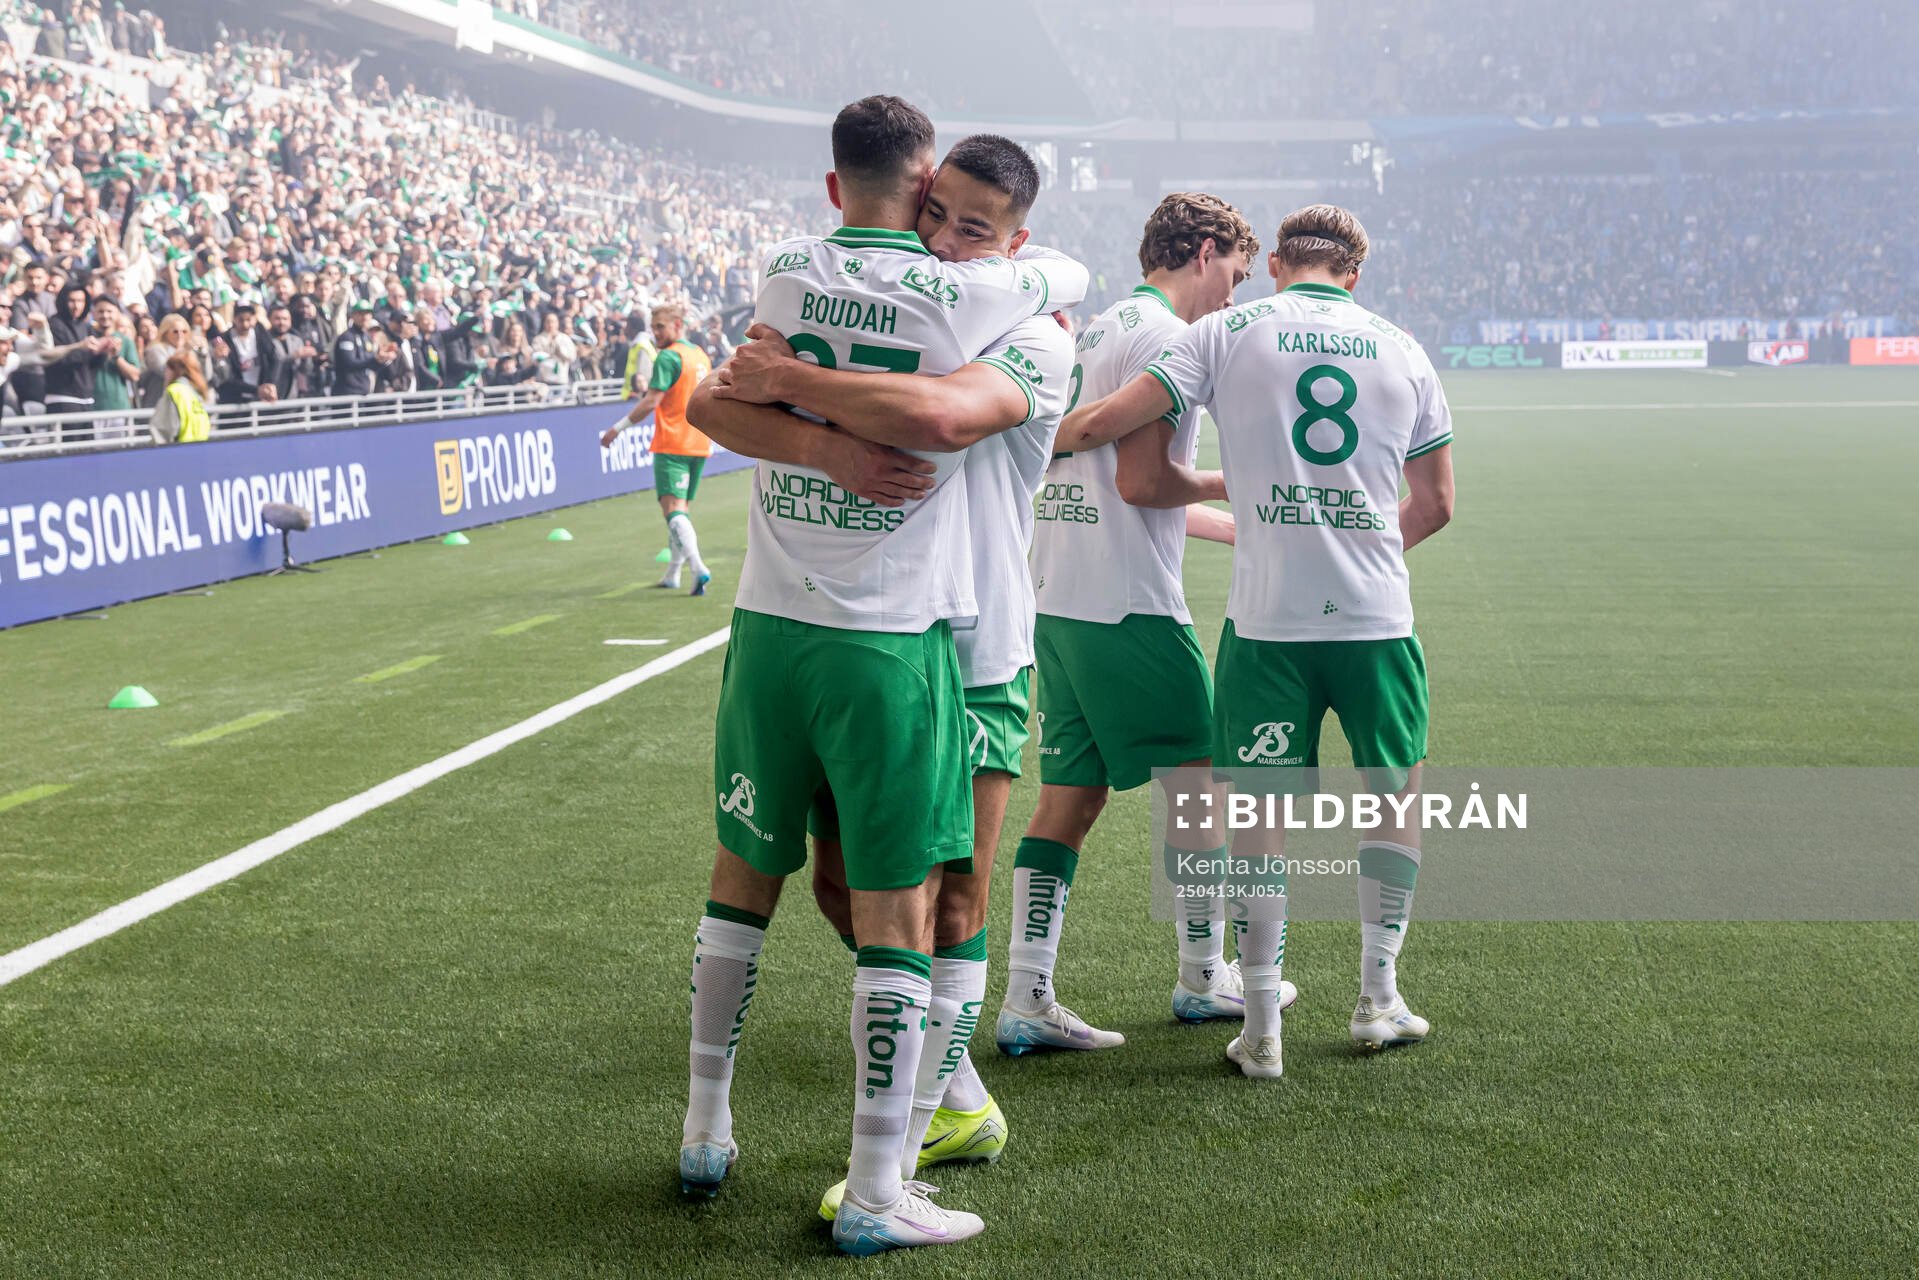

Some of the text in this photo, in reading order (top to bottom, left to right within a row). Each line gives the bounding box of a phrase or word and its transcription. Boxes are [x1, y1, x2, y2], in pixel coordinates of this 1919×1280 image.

[800, 291, 897, 334] BOUDAH
[1278, 331, 1377, 360] KARLSSON
[1291, 364, 1359, 466] 8
[459, 428, 557, 510] PROJOB
[761, 490, 905, 532] WELLNESS
[1272, 484, 1367, 508] NORDIC
[1256, 504, 1386, 531] WELLNESS
[762, 832, 774, 842] AB
